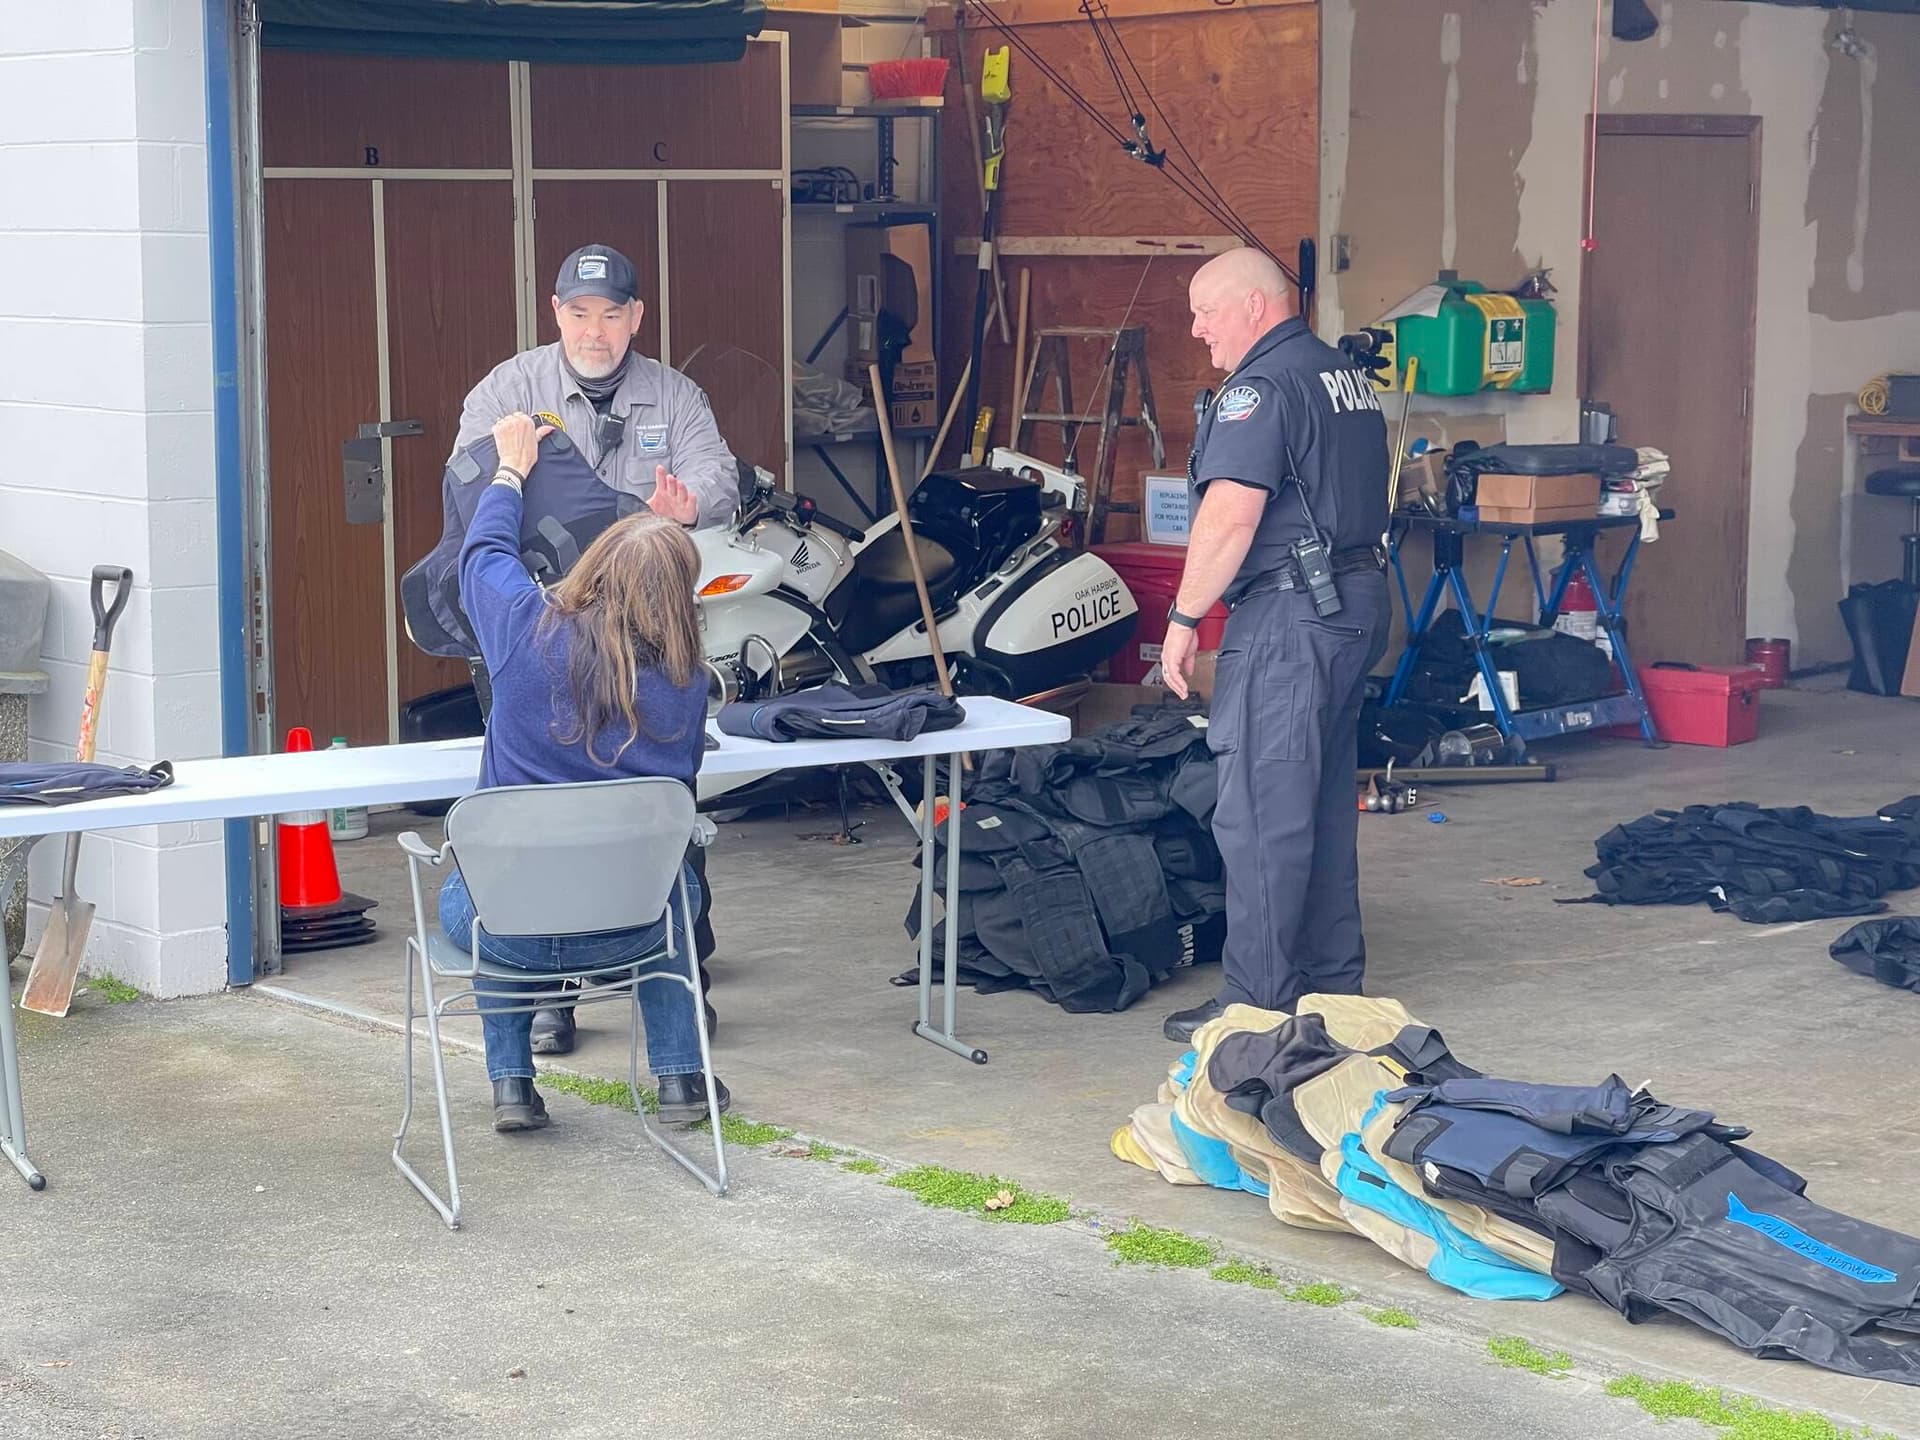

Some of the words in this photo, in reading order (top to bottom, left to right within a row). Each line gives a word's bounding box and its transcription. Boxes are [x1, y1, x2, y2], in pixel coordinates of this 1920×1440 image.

[364, 146, 379, 165] B
[654, 142, 667, 162] C
[1074, 588, 1091, 601] OAK
[1091, 577, 1119, 596] HARBOR
[1051, 590, 1121, 639] POLICE
